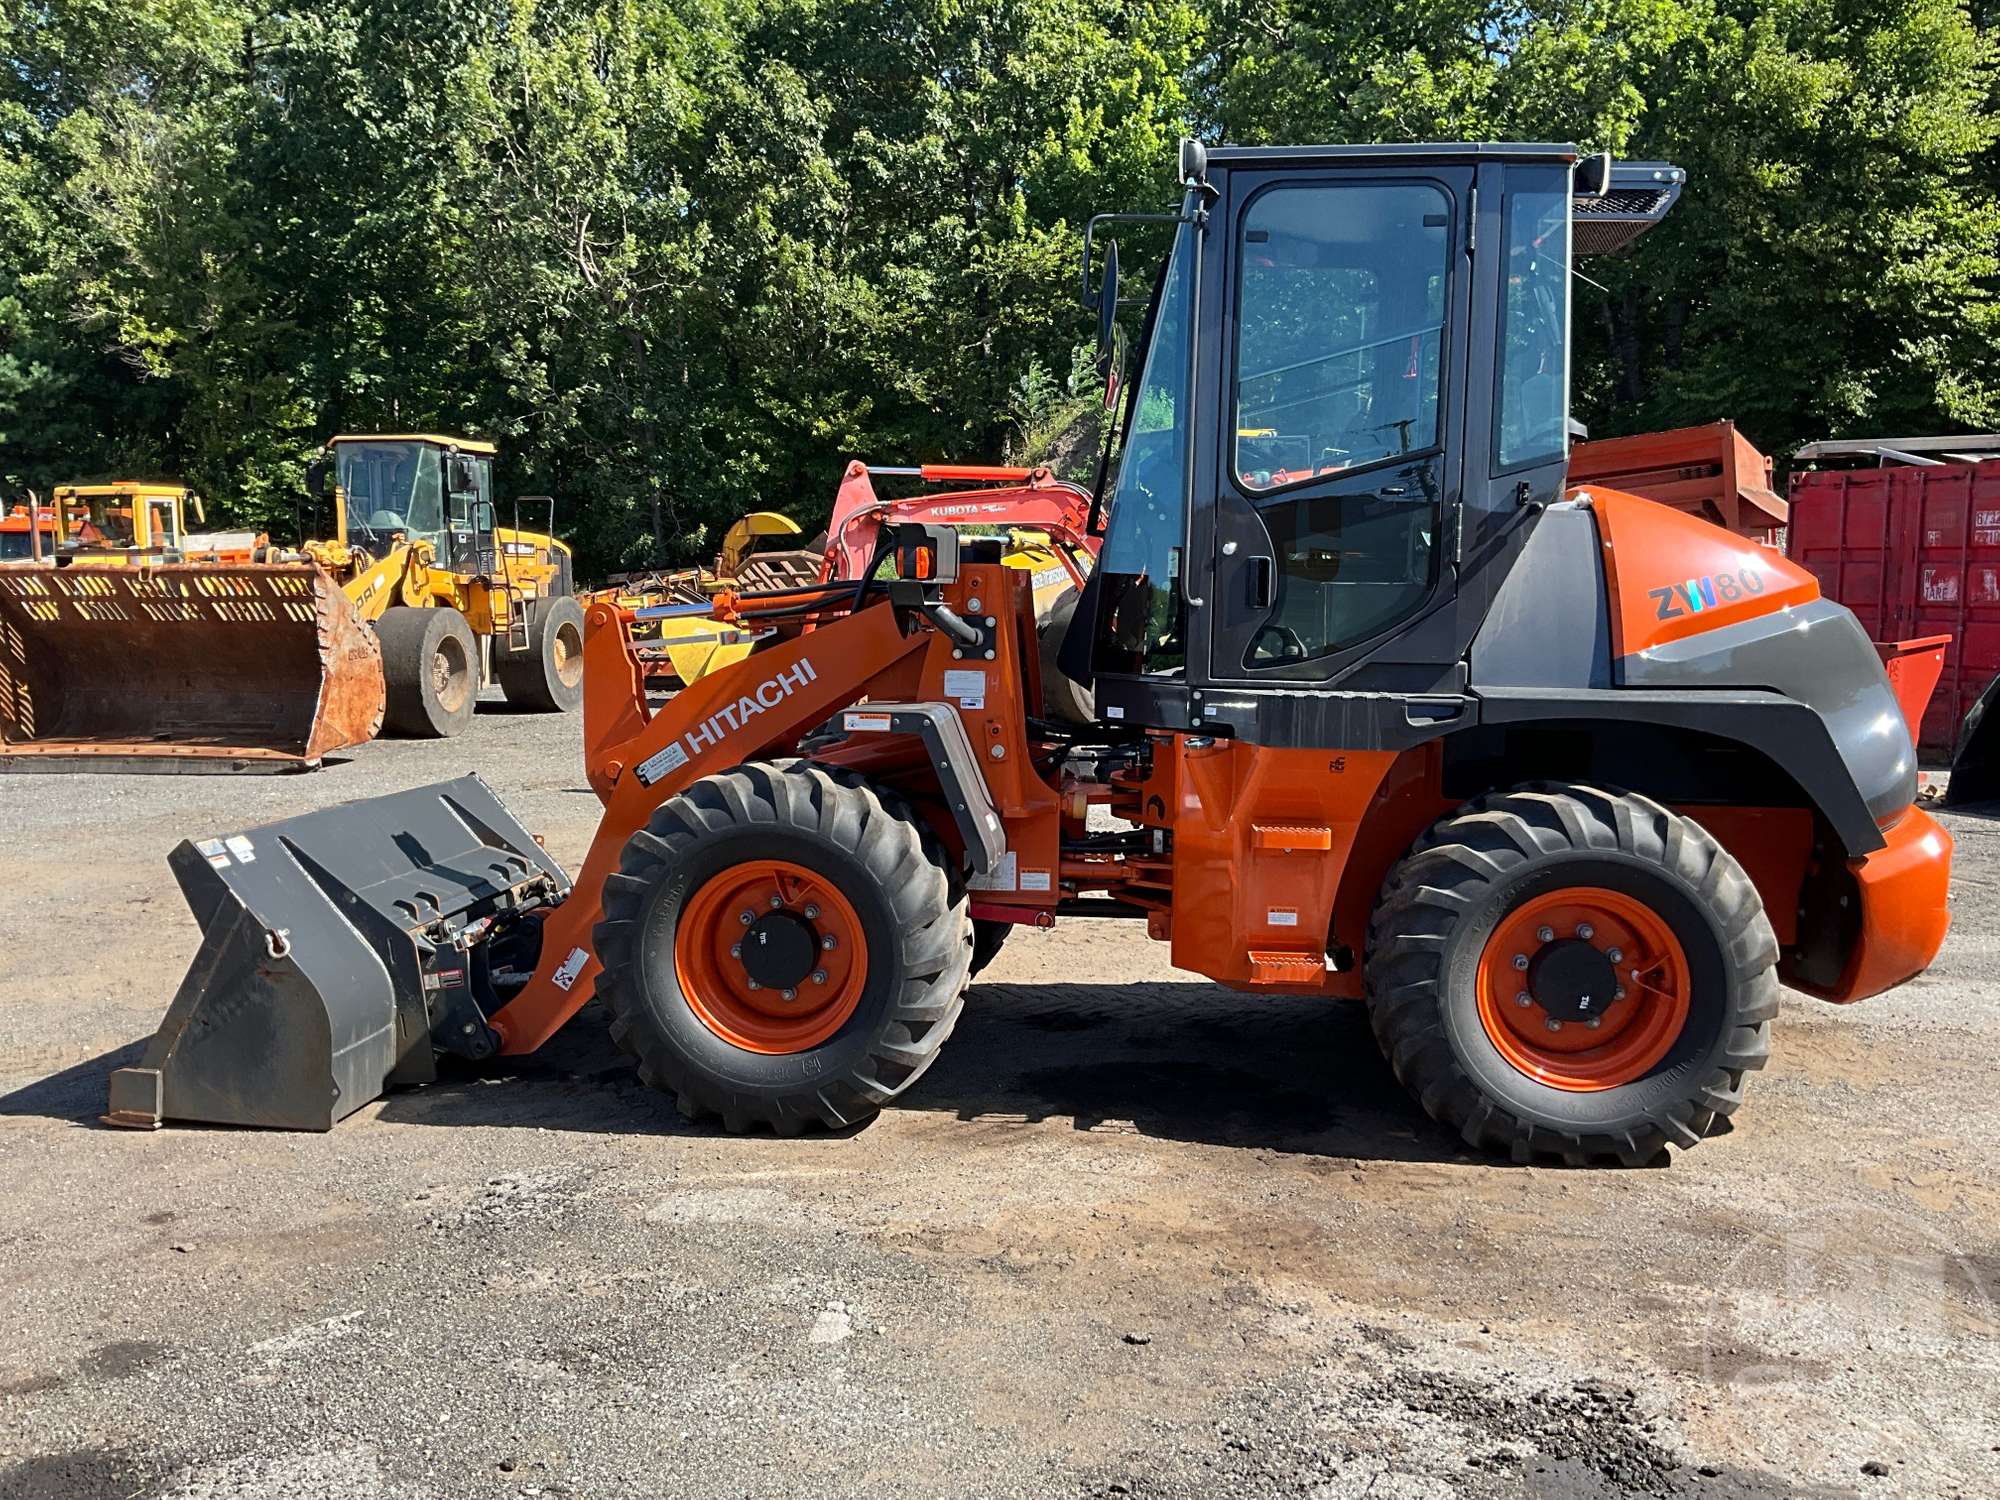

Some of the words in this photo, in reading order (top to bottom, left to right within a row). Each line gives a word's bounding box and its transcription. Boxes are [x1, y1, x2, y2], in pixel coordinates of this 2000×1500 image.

[931, 504, 978, 516] KUBOTA
[1648, 567, 1765, 620] ZW80
[684, 657, 817, 755] HITACHI
